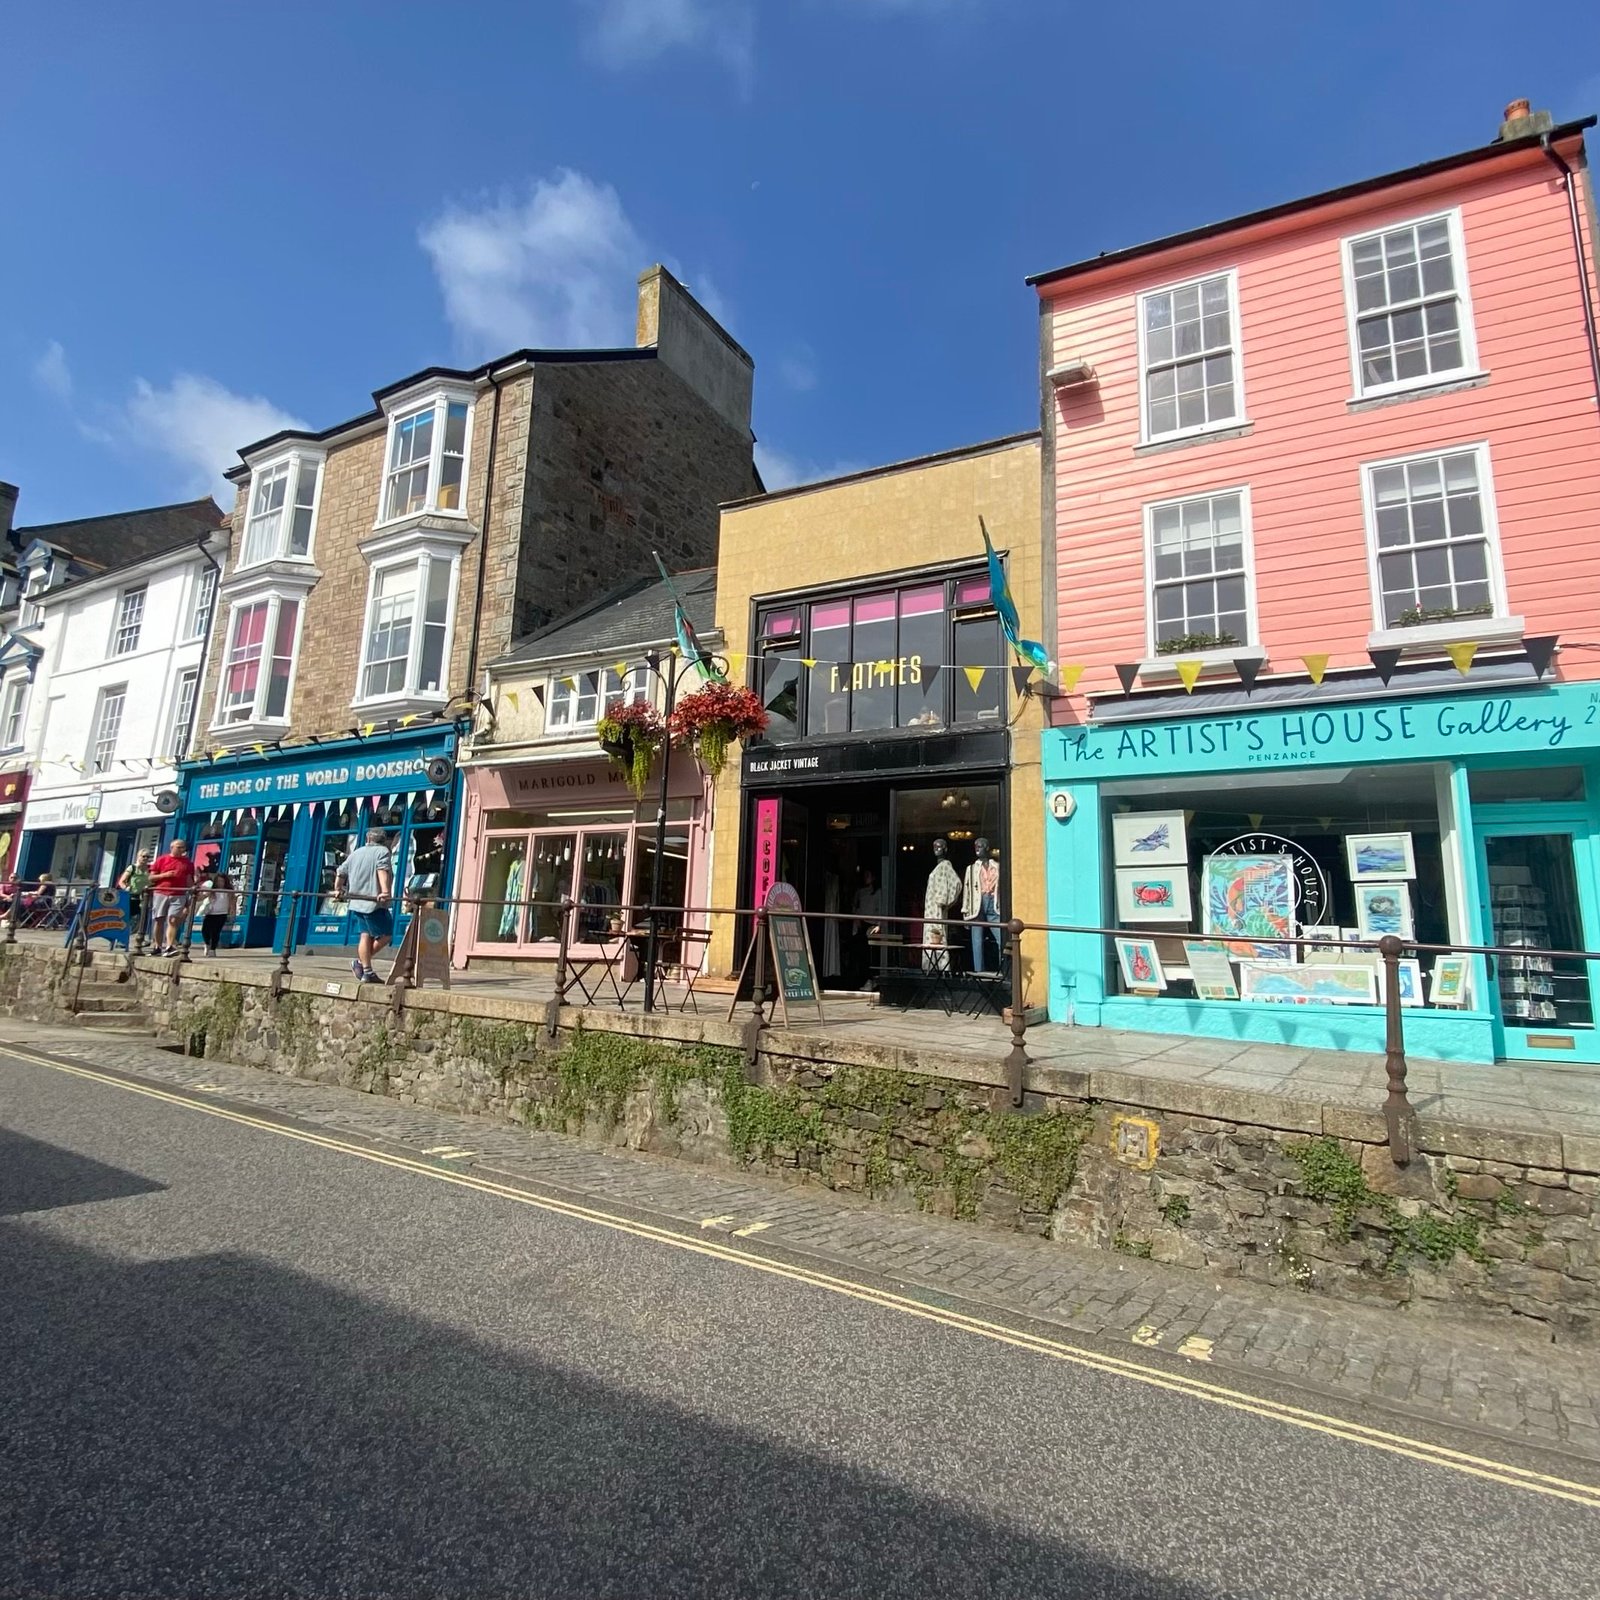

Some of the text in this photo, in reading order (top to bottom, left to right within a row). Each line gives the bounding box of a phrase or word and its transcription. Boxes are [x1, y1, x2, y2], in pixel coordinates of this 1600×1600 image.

[830, 655, 921, 693] FATTIES
[1059, 700, 1572, 761] The ARTIST'S HOUSE Gallery
[750, 756, 819, 772] BLACK JACKET VINTAGE
[1248, 750, 1317, 762] PENZANCE
[200, 758, 432, 799] THE EDGE OF THE WORLD BOOKSHO
[518, 773, 596, 791] MARIGOLD
[1293, 855, 1319, 907] HOUSE
